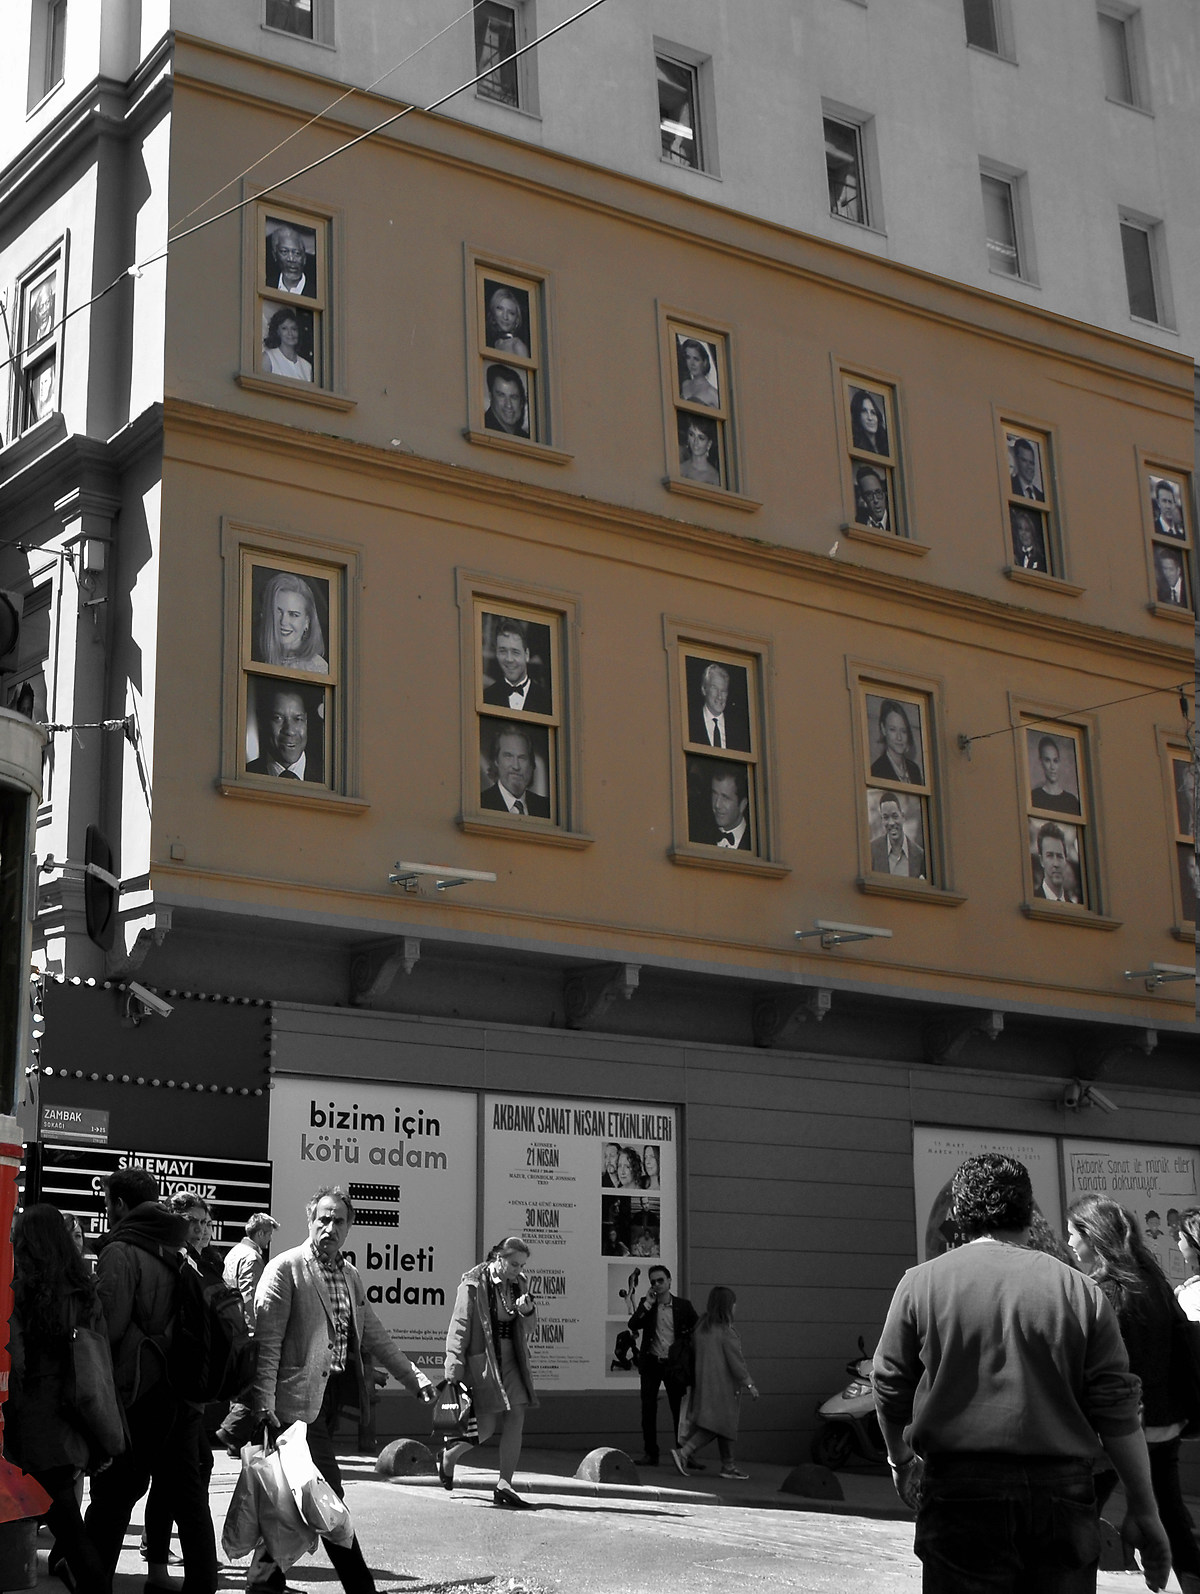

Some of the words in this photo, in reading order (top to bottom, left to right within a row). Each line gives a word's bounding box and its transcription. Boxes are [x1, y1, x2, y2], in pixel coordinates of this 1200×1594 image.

[44, 1109, 82, 1122] ZAMBAK
[310, 1100, 385, 1132] bizim
[394, 1107, 441, 1139] için
[493, 1103, 536, 1133] AKBANK
[537, 1107, 572, 1136] SANAT
[573, 1109, 606, 1137] NİSAN
[607, 1112, 673, 1142] ETKİNLİKLERİ
[118, 1151, 193, 1176] SİNEMAYI
[301, 1133, 360, 1164] kötü
[369, 1140, 448, 1170] adam
[526, 1147, 535, 1166] 21
[536, 1148, 559, 1168] NİSAN
[525, 1208, 535, 1227] 30
[537, 1209, 560, 1228] NİSAN
[366, 1243, 434, 1272] bileti
[366, 1277, 445, 1306] adam
[543, 1276, 566, 1295] NİSAN
[541, 1324, 564, 1343] NİSAN
